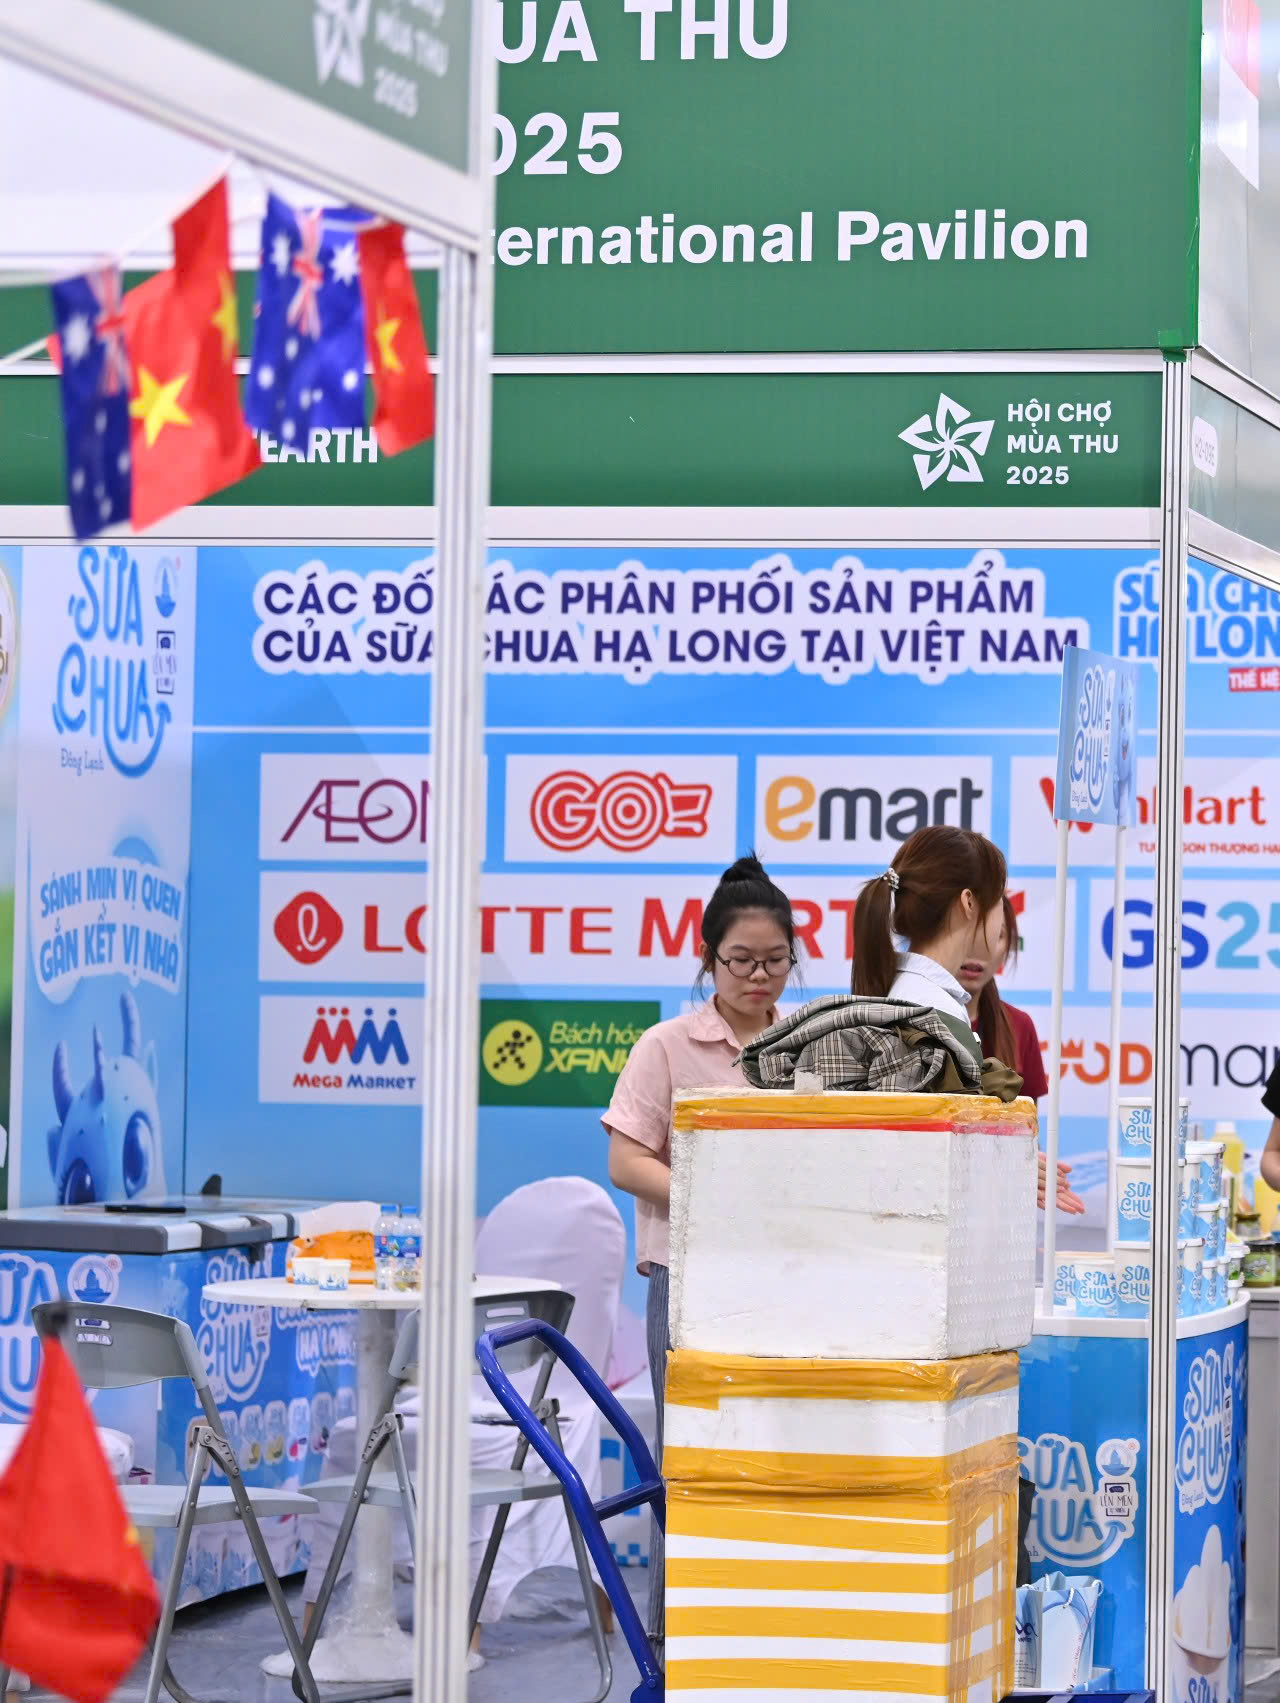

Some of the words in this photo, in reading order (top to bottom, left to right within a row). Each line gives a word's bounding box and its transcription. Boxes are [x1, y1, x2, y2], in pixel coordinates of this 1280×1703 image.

[624, 0, 788, 60] THU
[488, 112, 623, 176] 025
[490, 212, 813, 265] ernational
[837, 209, 1088, 263] Pavilion
[1008, 398, 1050, 428] HỘI
[1057, 400, 1112, 428] CHỢ
[1007, 428, 1062, 453] MÙA
[1069, 434, 1119, 453] THU
[1006, 465, 1070, 485] 2025
[264, 572, 358, 615] CÁC
[373, 567, 435, 615] ĐỐ
[486, 571, 545, 615] ÁC
[561, 572, 675, 614] PHÂN
[692, 566, 793, 614] PHỐI
[809, 568, 892, 614] SẢN
[910, 560, 1034, 614] PHẨM
[263, 617, 352, 663] CỦA
[485, 630, 578, 662] HUA
[595, 630, 653, 673] HẠ
[669, 629, 787, 663] LONG
[801, 629, 863, 673] TẠI
[880, 619, 965, 673] VIỆT
[980, 629, 1078, 663] NAM
[52, 642, 171, 778] CHUA
[764, 776, 984, 842] emart
[123, 868, 138, 911] VỊ
[142, 873, 182, 921] QUEN
[123, 923, 140, 977] VỊ
[550, 1020, 602, 1045] Bách
[1119, 1197, 1150, 1219] CHU
